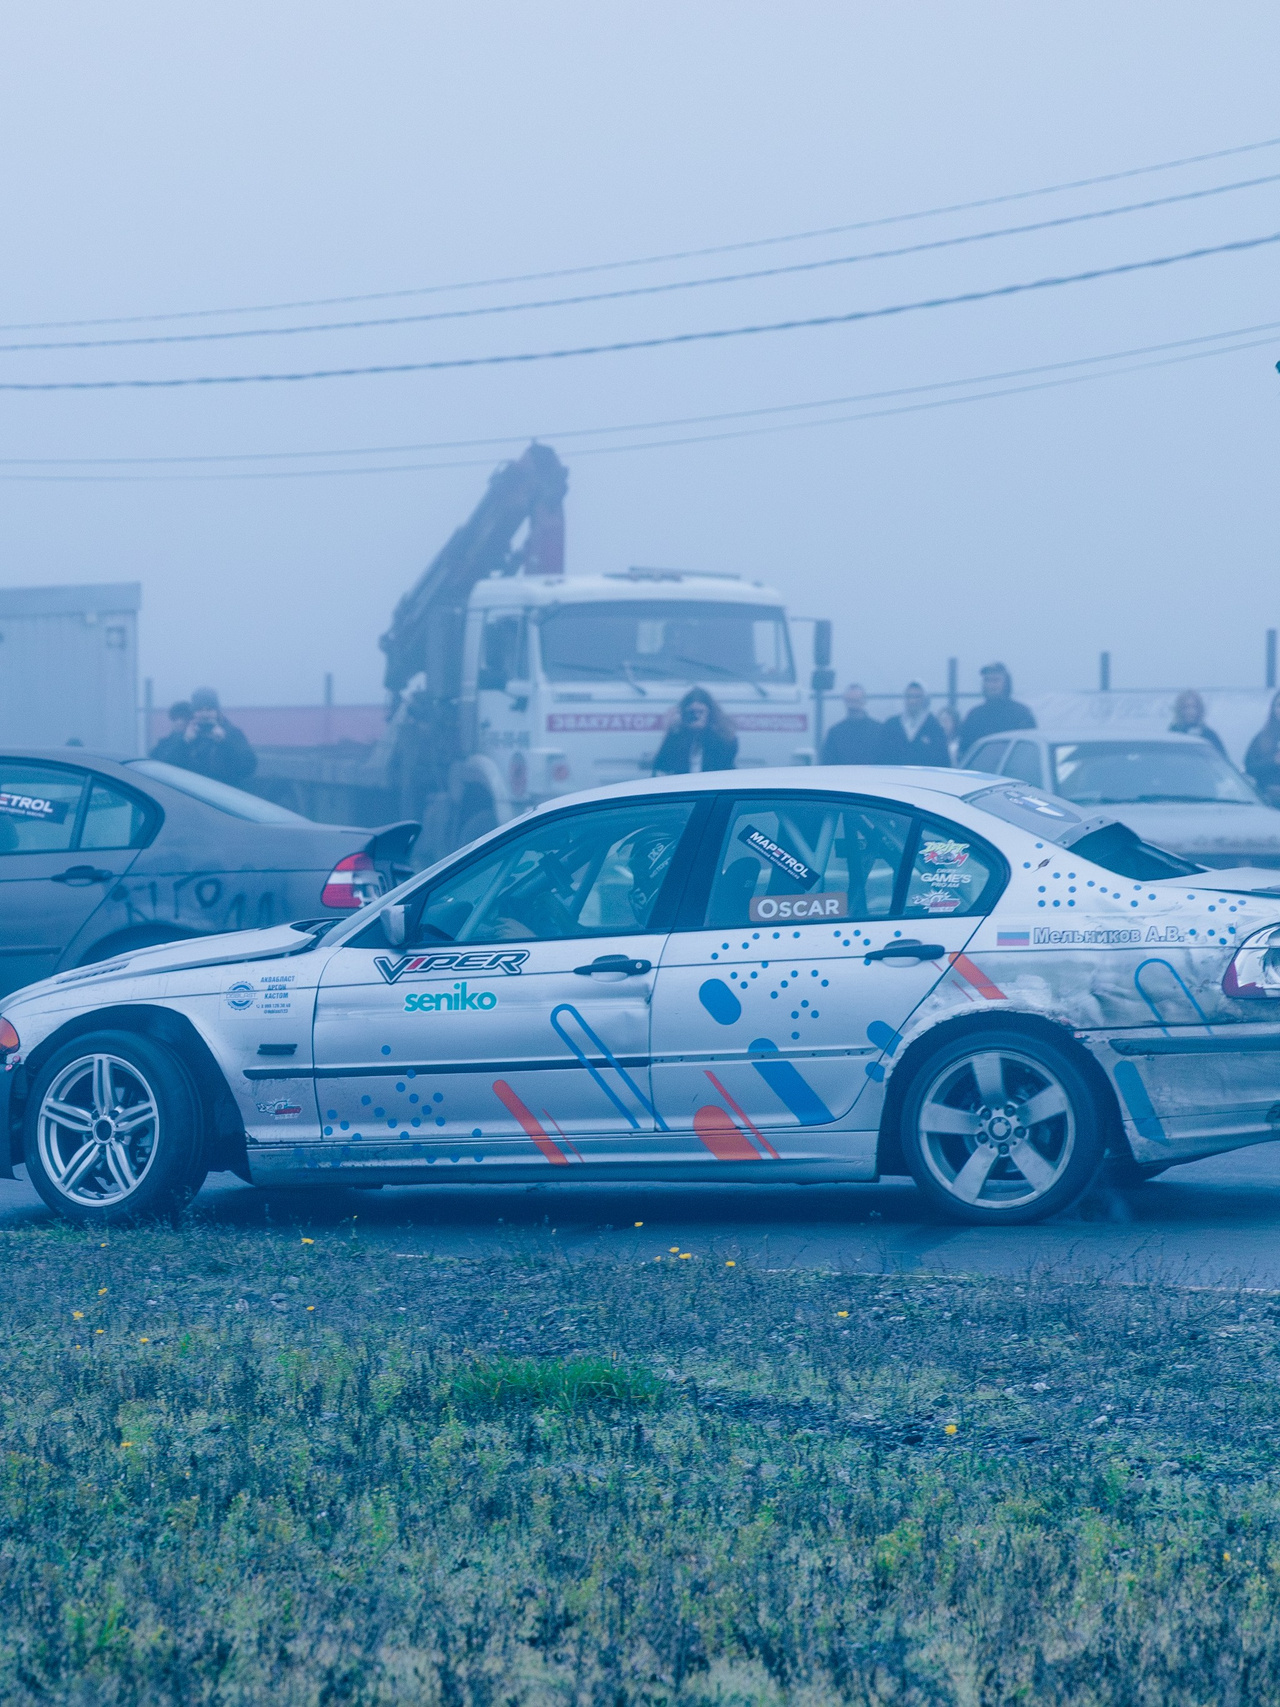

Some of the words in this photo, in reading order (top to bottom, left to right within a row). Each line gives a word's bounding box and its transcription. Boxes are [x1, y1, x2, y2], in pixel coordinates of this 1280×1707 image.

[749, 831, 809, 878] MAPETROL
[920, 873, 972, 883] GAME'S
[1033, 926, 1140, 944] Мельников
[1146, 926, 1185, 942] А.В.
[260, 975, 296, 983] АКВАБЛАСТ
[374, 949, 531, 985] VIPER
[404, 982, 497, 1012] seniko
